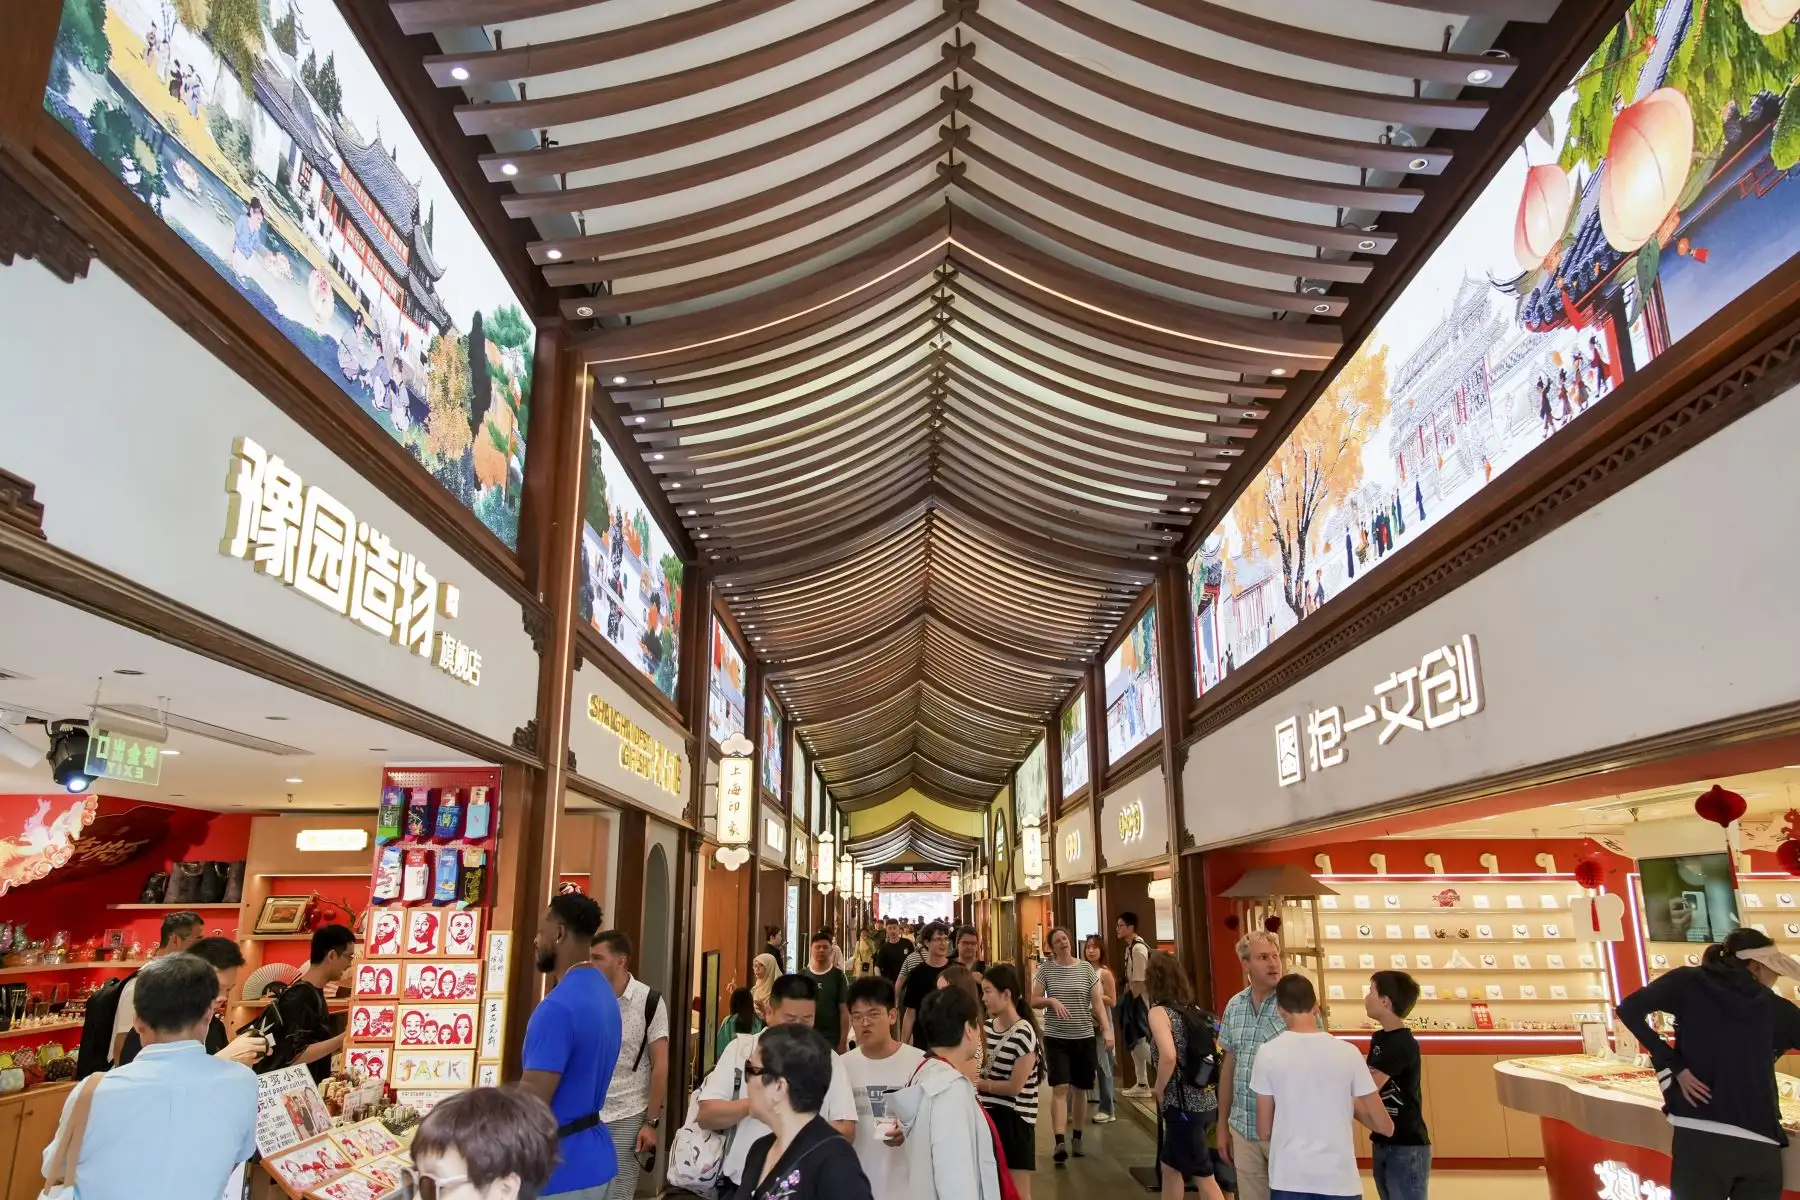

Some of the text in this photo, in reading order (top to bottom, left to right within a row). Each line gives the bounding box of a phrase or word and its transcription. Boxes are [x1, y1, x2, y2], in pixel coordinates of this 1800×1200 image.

[219, 436, 437, 658] 豫园造物
[272, 1084, 289, 1096] paper
